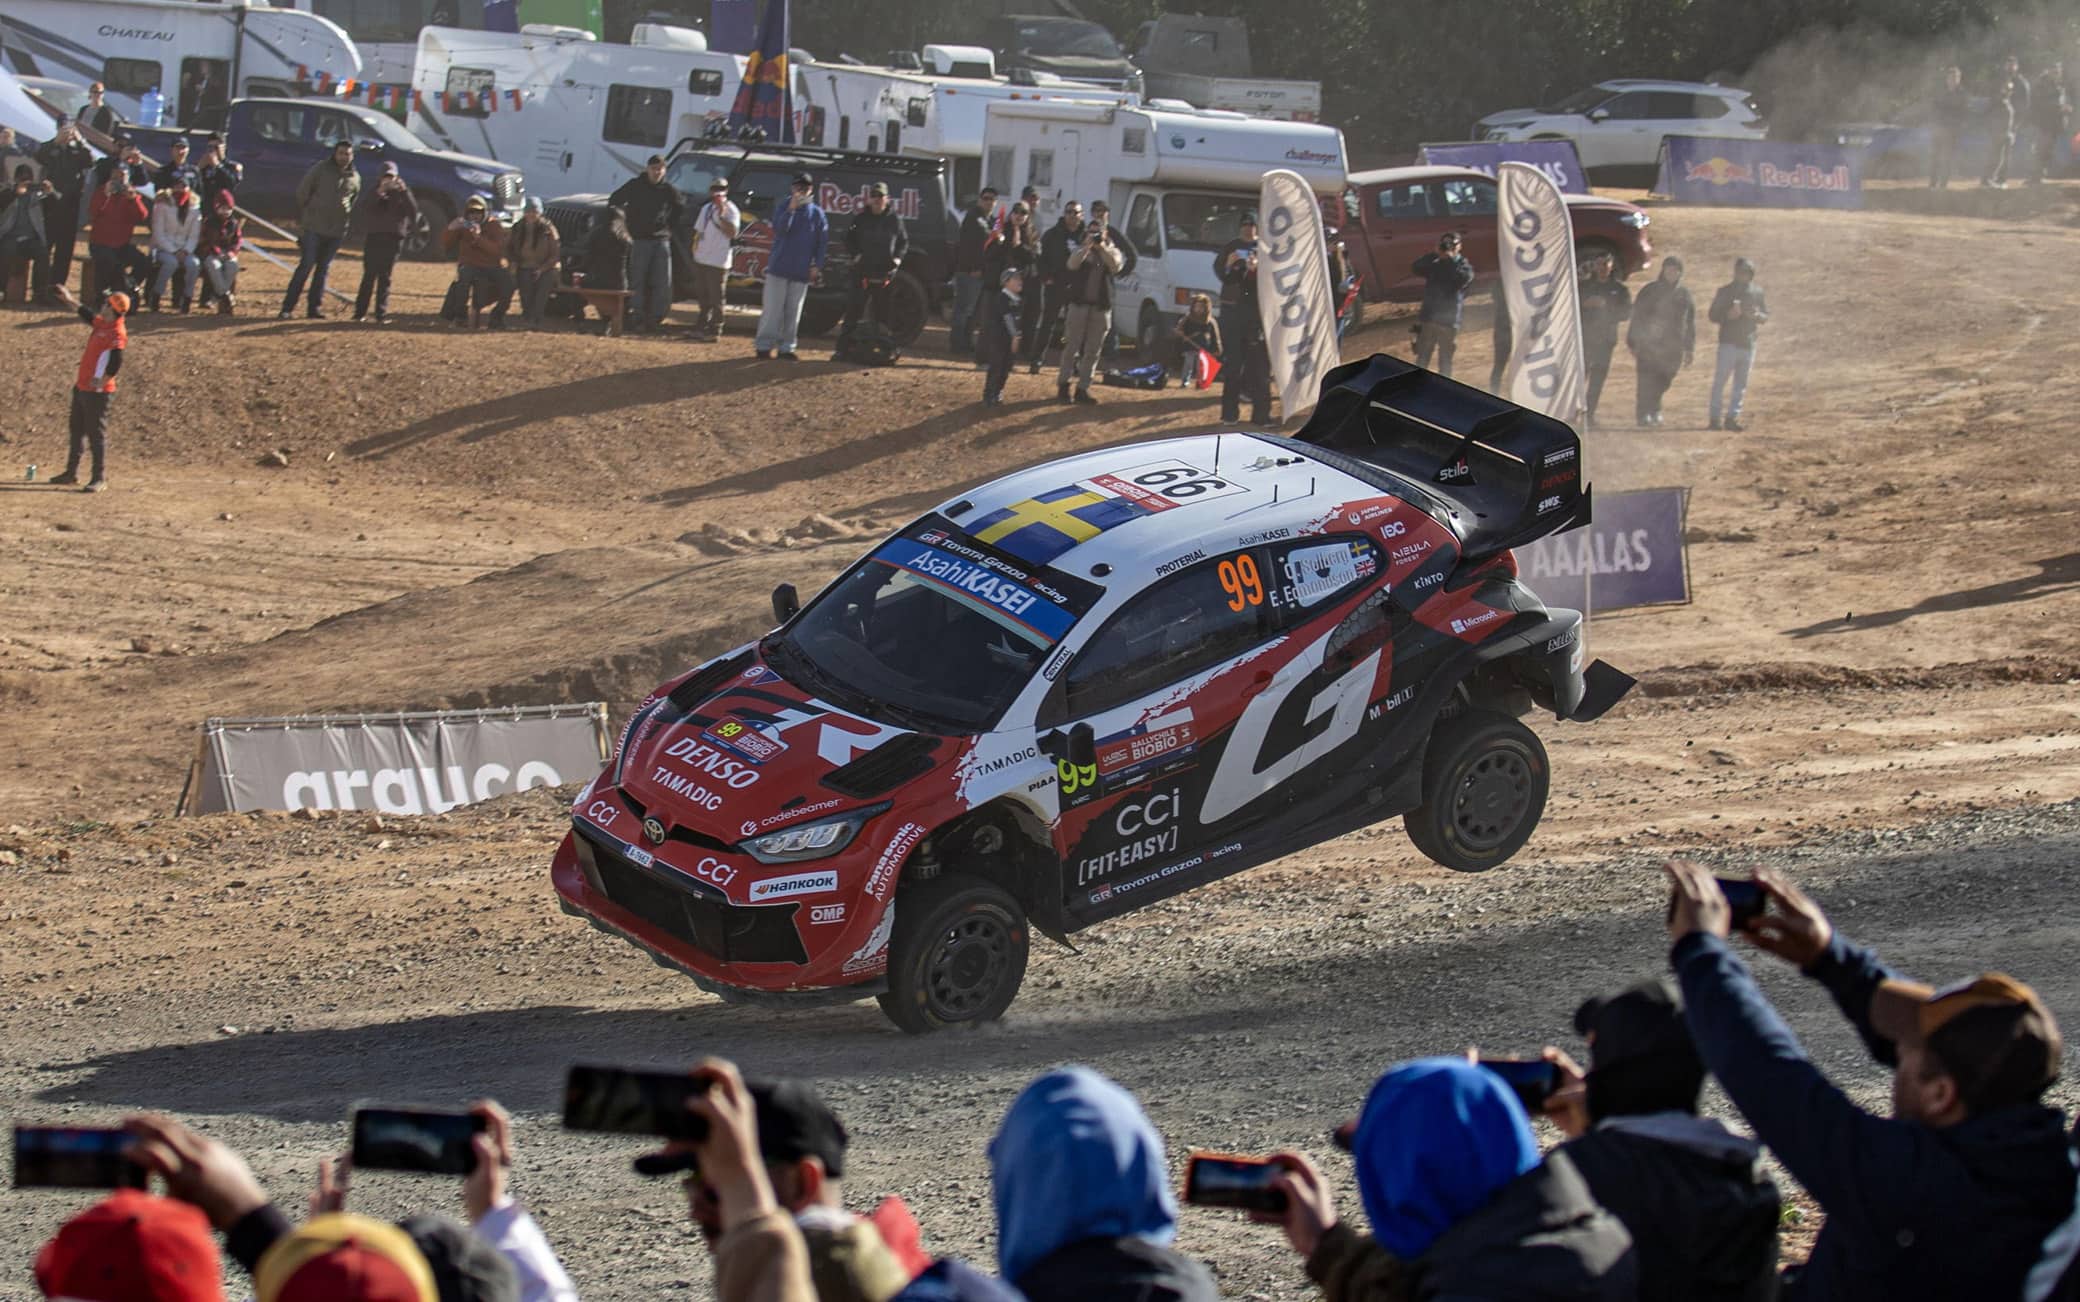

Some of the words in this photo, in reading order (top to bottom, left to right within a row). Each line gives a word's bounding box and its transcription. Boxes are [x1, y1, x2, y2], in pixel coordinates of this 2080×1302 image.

[98, 24, 175, 42] CHATEAU
[1759, 162, 1804, 188] Red
[1805, 164, 1849, 191] Bull
[1238, 528, 1290, 546] AsahiKASEI
[941, 538, 984, 561] TOYOTA
[984, 556, 1028, 581] GAZOO
[1026, 575, 1068, 604] Racing
[1156, 548, 1207, 577] PROTERIAL
[907, 550, 1037, 615] AsahiKASEI
[1217, 554, 1264, 612] 99
[1464, 610, 1498, 627] Microsoft
[717, 722, 743, 737] 99
[975, 747, 1036, 776] TAMADIC
[1132, 735, 1177, 760] BIOBIO
[665, 737, 760, 789] DENSO
[283, 760, 562, 815] arauco
[652, 766, 722, 811] TAMADIC
[1028, 776, 1056, 792] PIAA
[761, 799, 841, 827] codebeamer
[864, 822, 915, 896] Panasonic
[874, 825, 926, 902] AUTOMOTIVE
[1113, 873, 1160, 894] TOYOTA
[1160, 856, 1203, 877] GAZOO
[1203, 842, 1243, 860] Racing
[811, 908, 845, 921] OMP
